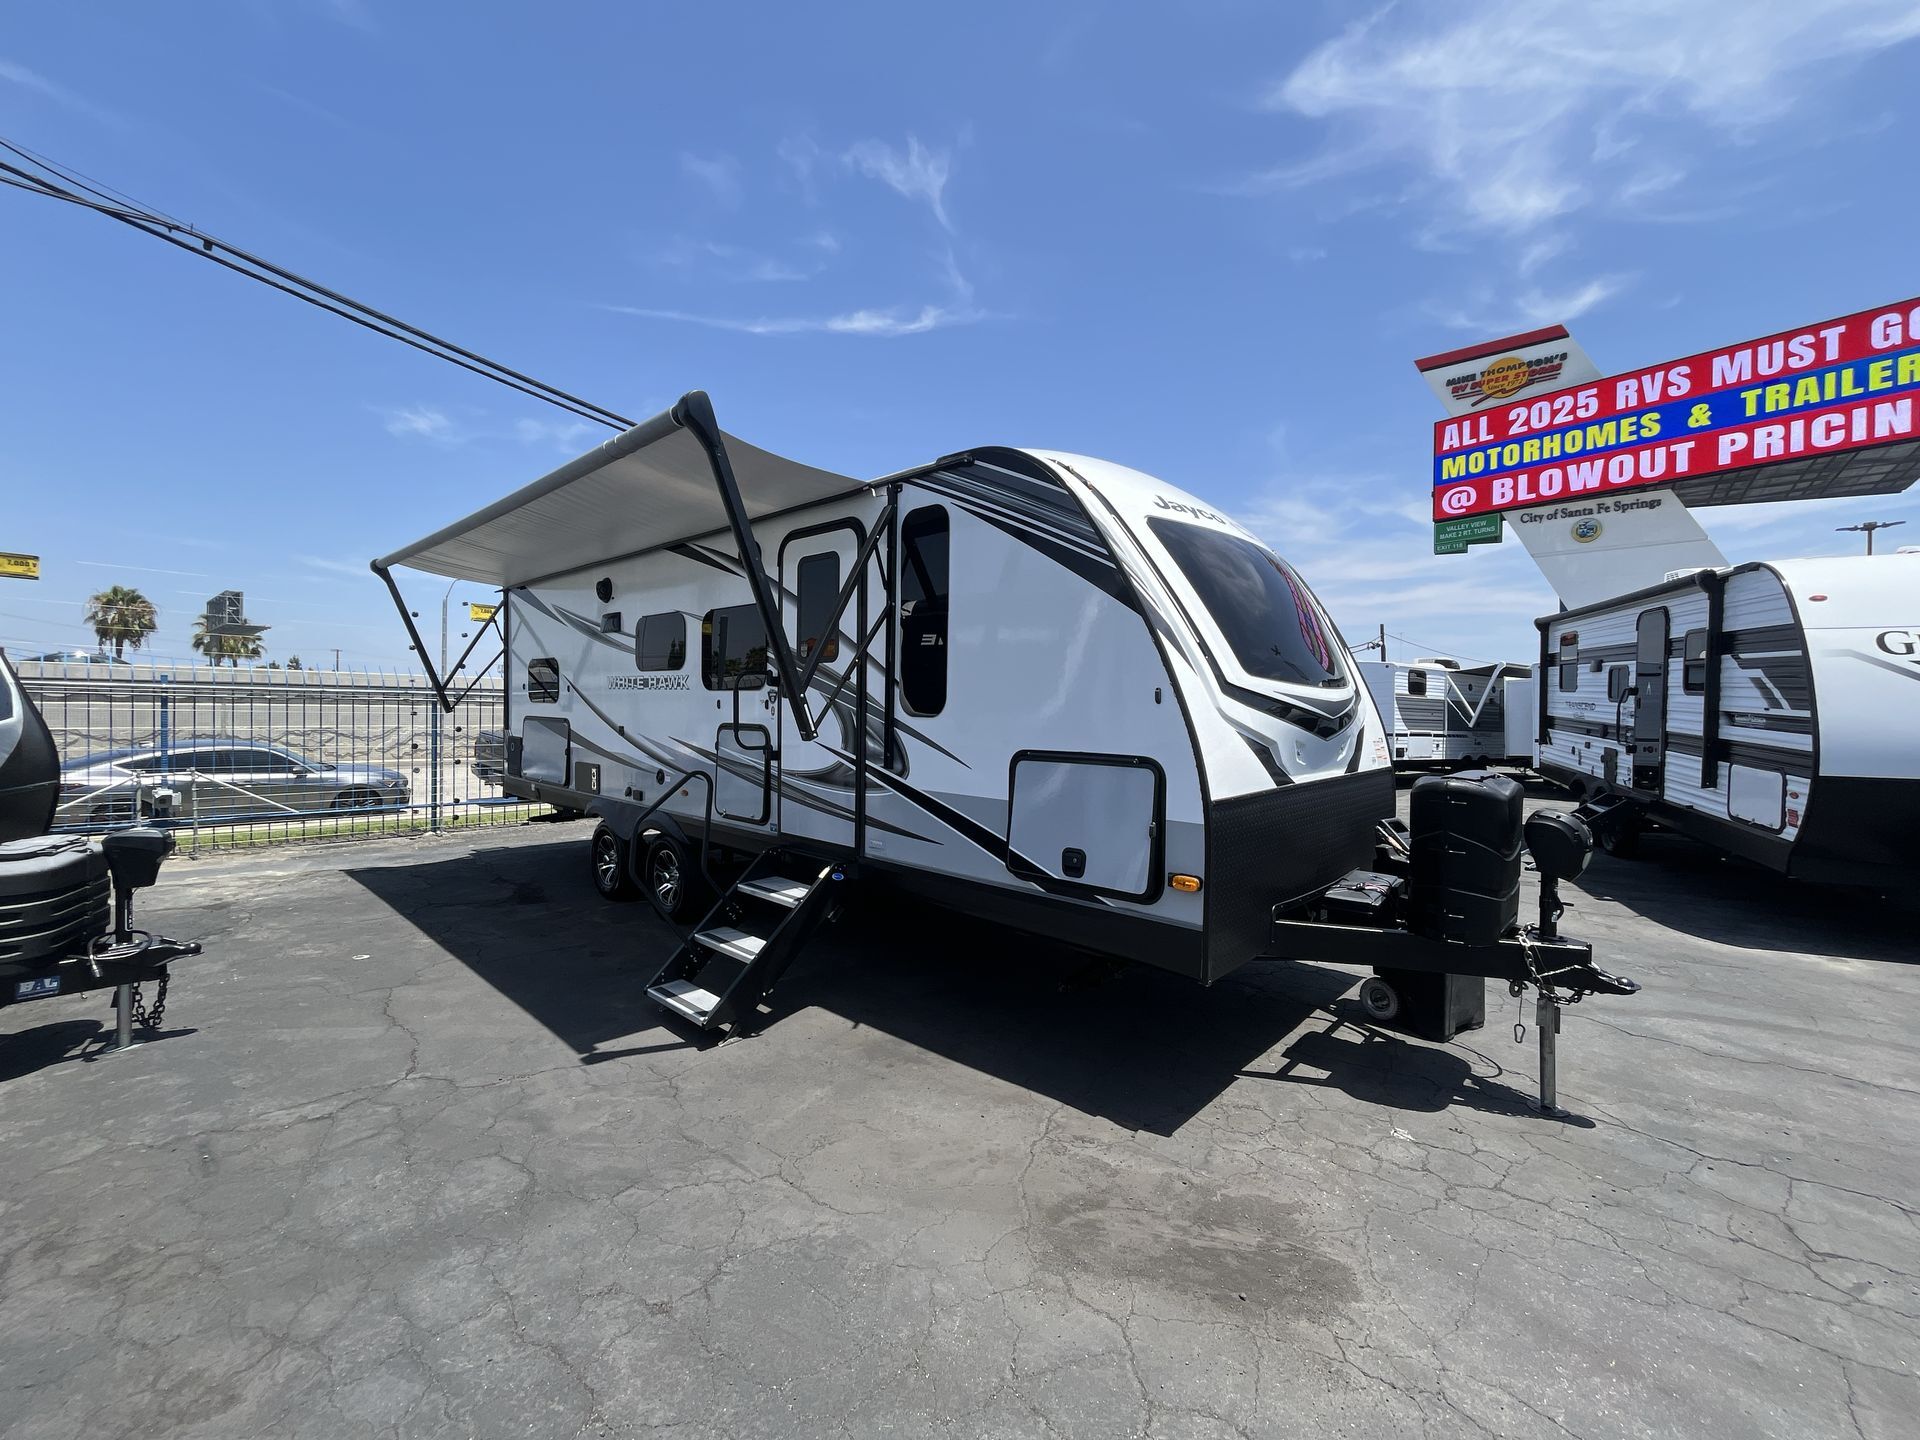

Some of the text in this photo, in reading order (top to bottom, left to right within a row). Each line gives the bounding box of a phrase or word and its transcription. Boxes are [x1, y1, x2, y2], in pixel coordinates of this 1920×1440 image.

[1446, 352, 1568, 387] MIKE THOMPSON'S
[1451, 363, 1563, 394] RV SUPER STORES
[1442, 416, 1494, 450] ALL
[1508, 388, 1599, 436] 2025
[1616, 365, 1692, 410] RVS
[1711, 325, 1846, 388] MUST
[1487, 382, 1505, 392] Since
[1441, 398, 1912, 514] @ BLOWOUT PRICIN
[1442, 412, 1661, 480] MOTORHOMES
[1687, 403, 1713, 429] &
[1153, 494, 1226, 525] Jayco
[1520, 497, 1662, 526] City of Santa Fe Springs
[1439, 532, 1457, 540] MAKE
[1474, 525, 1496, 534] TURNS
[1446, 520, 1487, 531] VALLEY VIEW
[1875, 630, 1920, 656] G
[606, 674, 690, 690] WHITE HAWK
